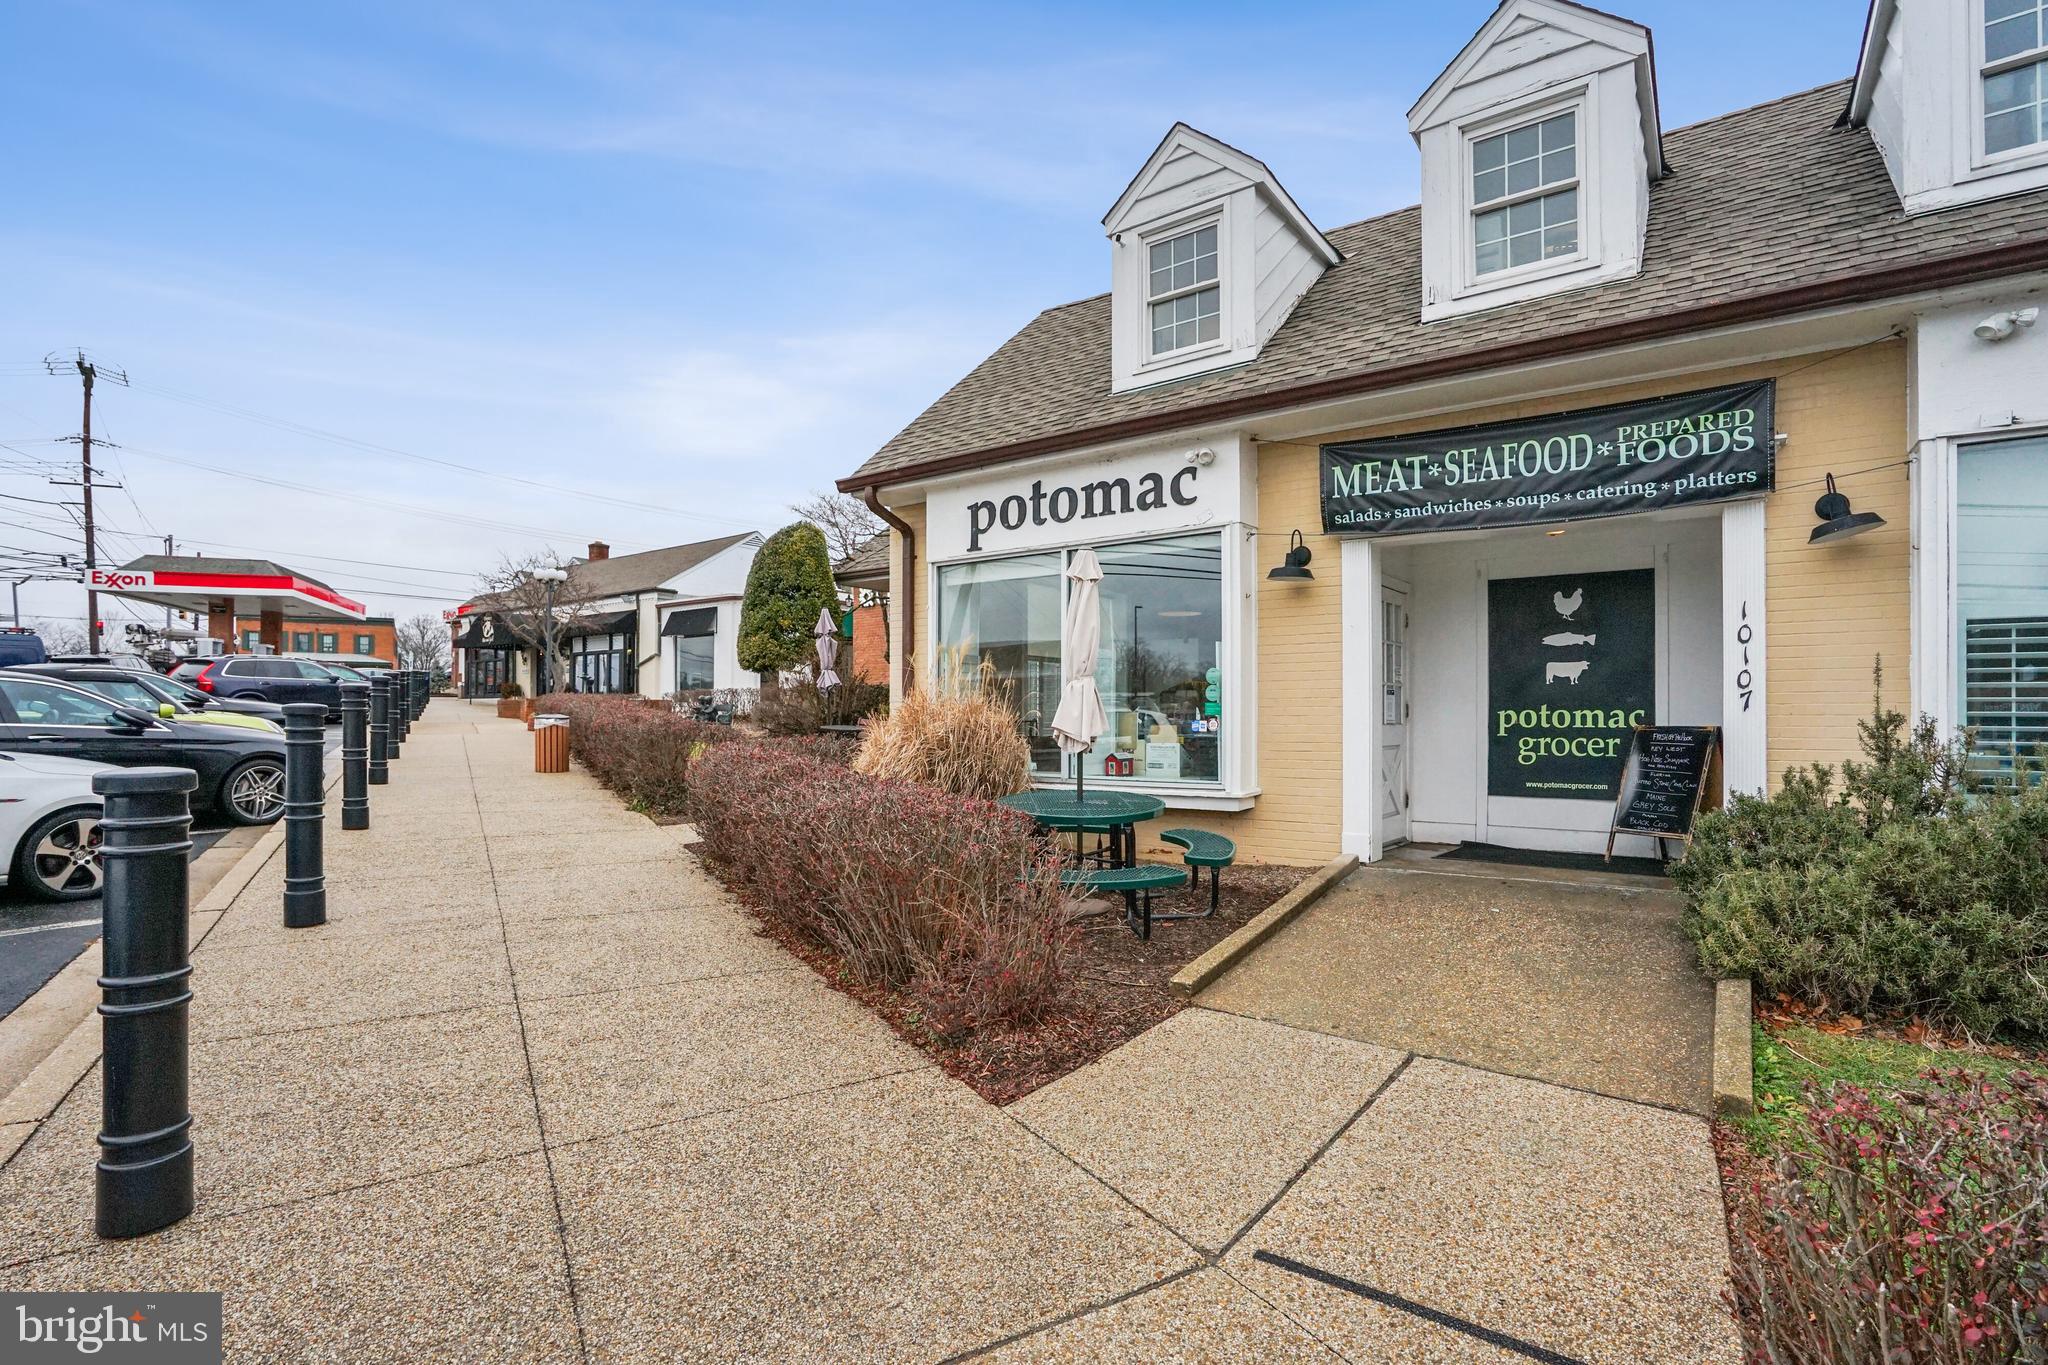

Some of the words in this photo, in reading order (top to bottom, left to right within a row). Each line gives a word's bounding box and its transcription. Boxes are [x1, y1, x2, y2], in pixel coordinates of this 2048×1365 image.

[1616, 408, 1755, 443] PREPARED
[1331, 455, 1428, 499] MEAT
[1444, 433, 1593, 486] SEAFOOD
[1616, 426, 1755, 467] FOODS
[966, 466, 1198, 552] potomac
[1334, 510, 1381, 524] salads
[1394, 498, 1492, 518] sandwiches
[1506, 491, 1560, 509] soups
[1576, 480, 1657, 500] catering
[1674, 470, 1757, 495] platters
[91, 570, 146, 590] Exxon
[1736, 600, 1752, 712] 10107
[1496, 704, 1646, 737] potomac
[1518, 736, 1621, 765] grocer
[1525, 781, 1608, 791] www.potomacgrocer.com
[1645, 793, 1667, 801] MAINE
[1632, 800, 1656, 811] GREY
